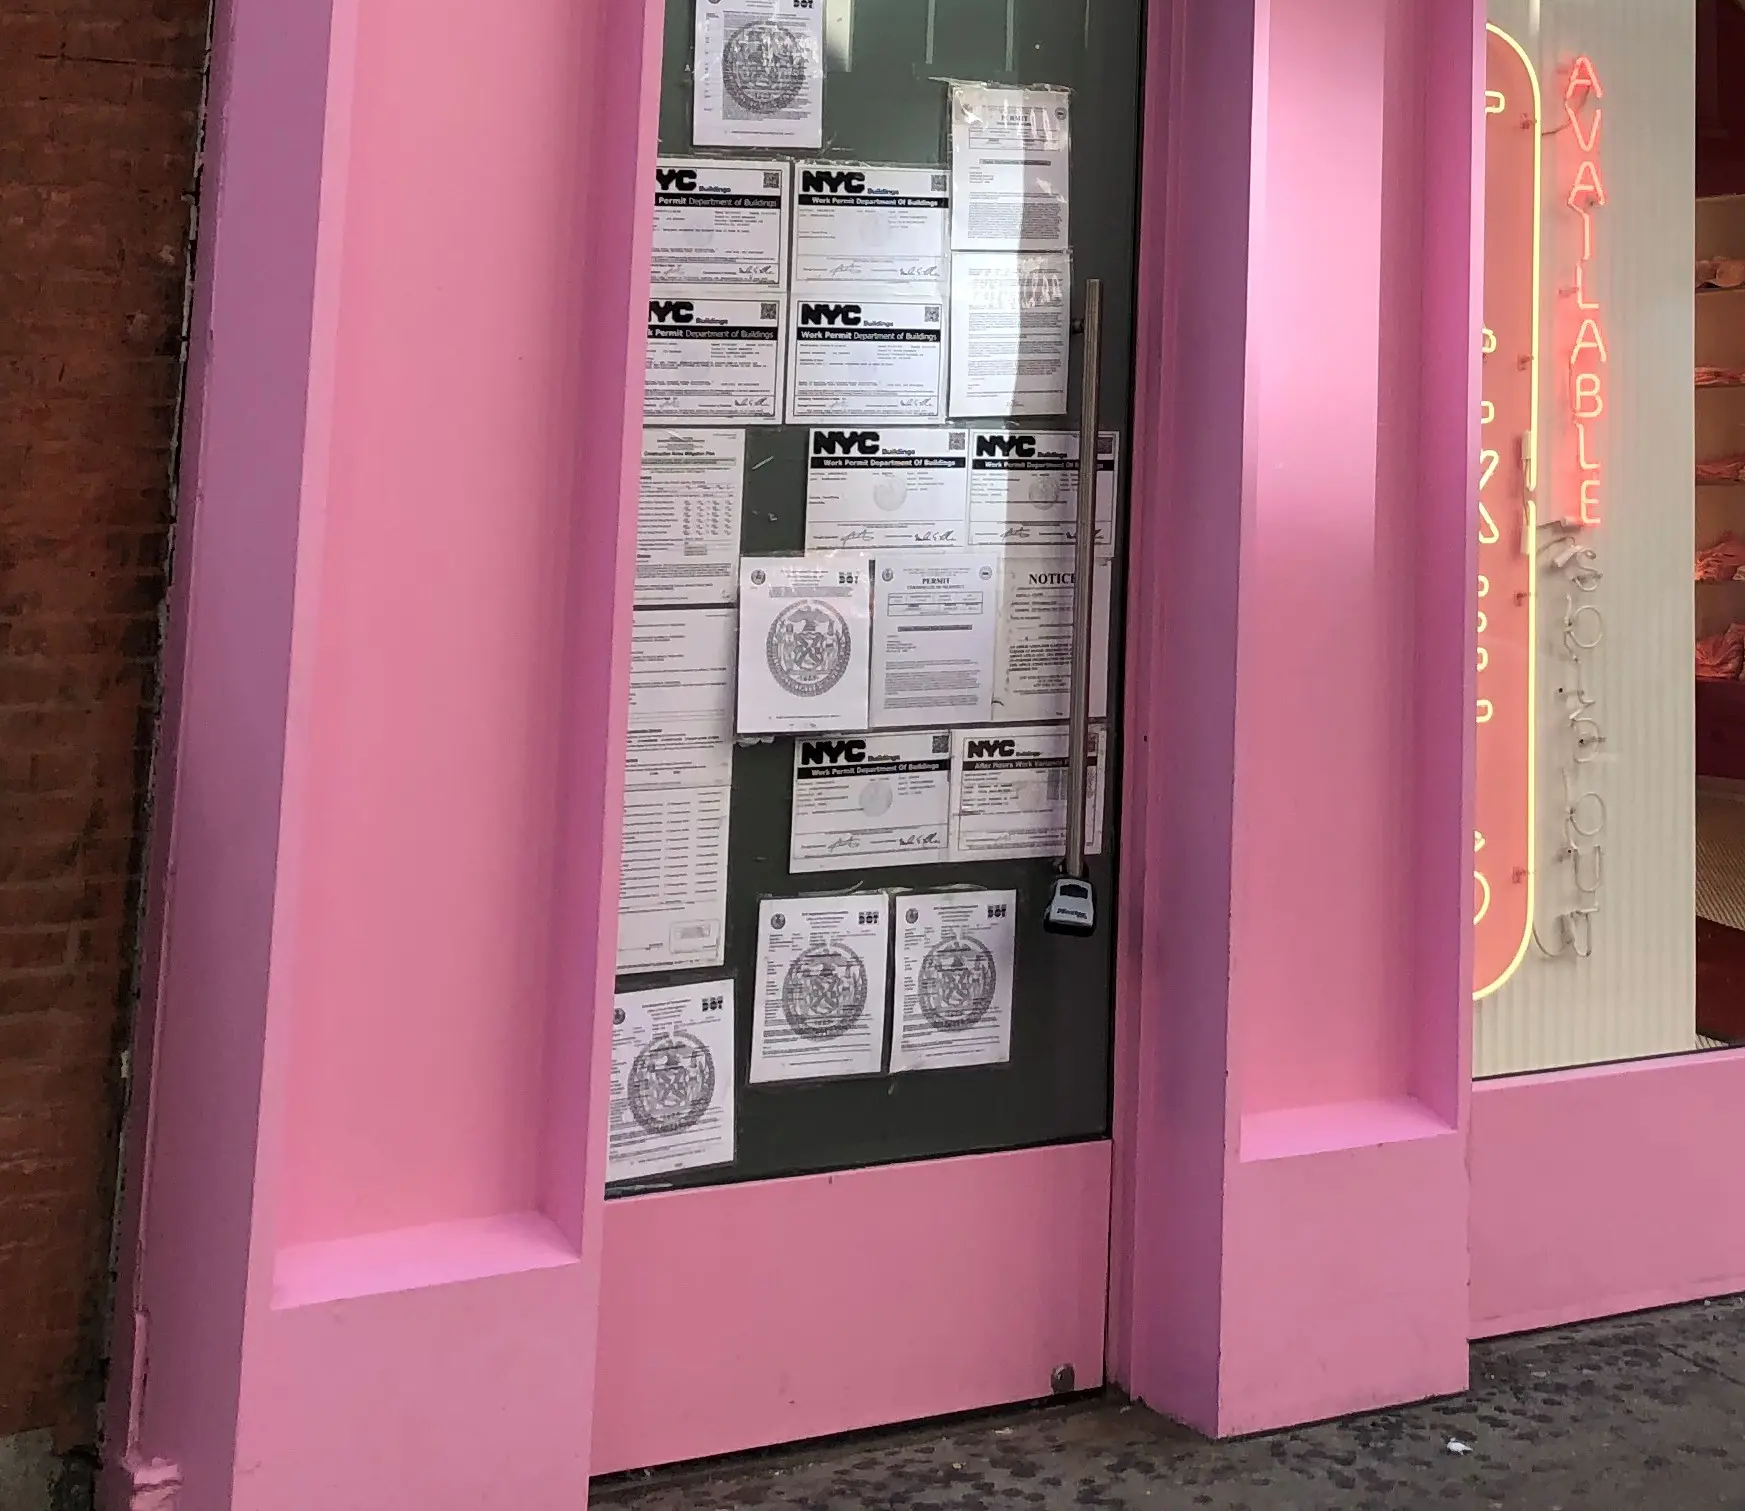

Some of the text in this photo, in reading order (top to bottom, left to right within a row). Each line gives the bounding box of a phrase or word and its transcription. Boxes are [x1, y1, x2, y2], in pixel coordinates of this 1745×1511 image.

[656, 169, 697, 191] YC
[802, 170, 865, 193] NYC
[658, 196, 777, 207] Permit Department of Buildings
[832, 197, 854, 205] Permit
[856, 198, 896, 206] Department
[908, 199, 938, 207] Buildings
[1566, 57, 1607, 525] AVAILABLE
[648, 301, 694, 323] YC
[801, 303, 861, 326] NYC
[696, 317, 728, 325] Buildings
[655, 329, 684, 337] Permit
[685, 329, 729, 339] Department
[731, 329, 739, 337] of
[741, 330, 773, 339] Buildings
[801, 331, 937, 341] Work Permit Department of Buildings
[813, 431, 880, 454] NYC
[976, 435, 1036, 457] NYC
[870, 459, 912, 467] Department
[924, 459, 955, 467] Buildings
[922, 577, 950, 585] PERMIT
[802, 740, 866, 765] NYC
[968, 739, 1015, 758] NYC
[832, 767, 854, 775] Permit
[857, 765, 897, 774] Department
[908, 763, 939, 771] Buildings
[993, 761, 1014, 769] Hours
